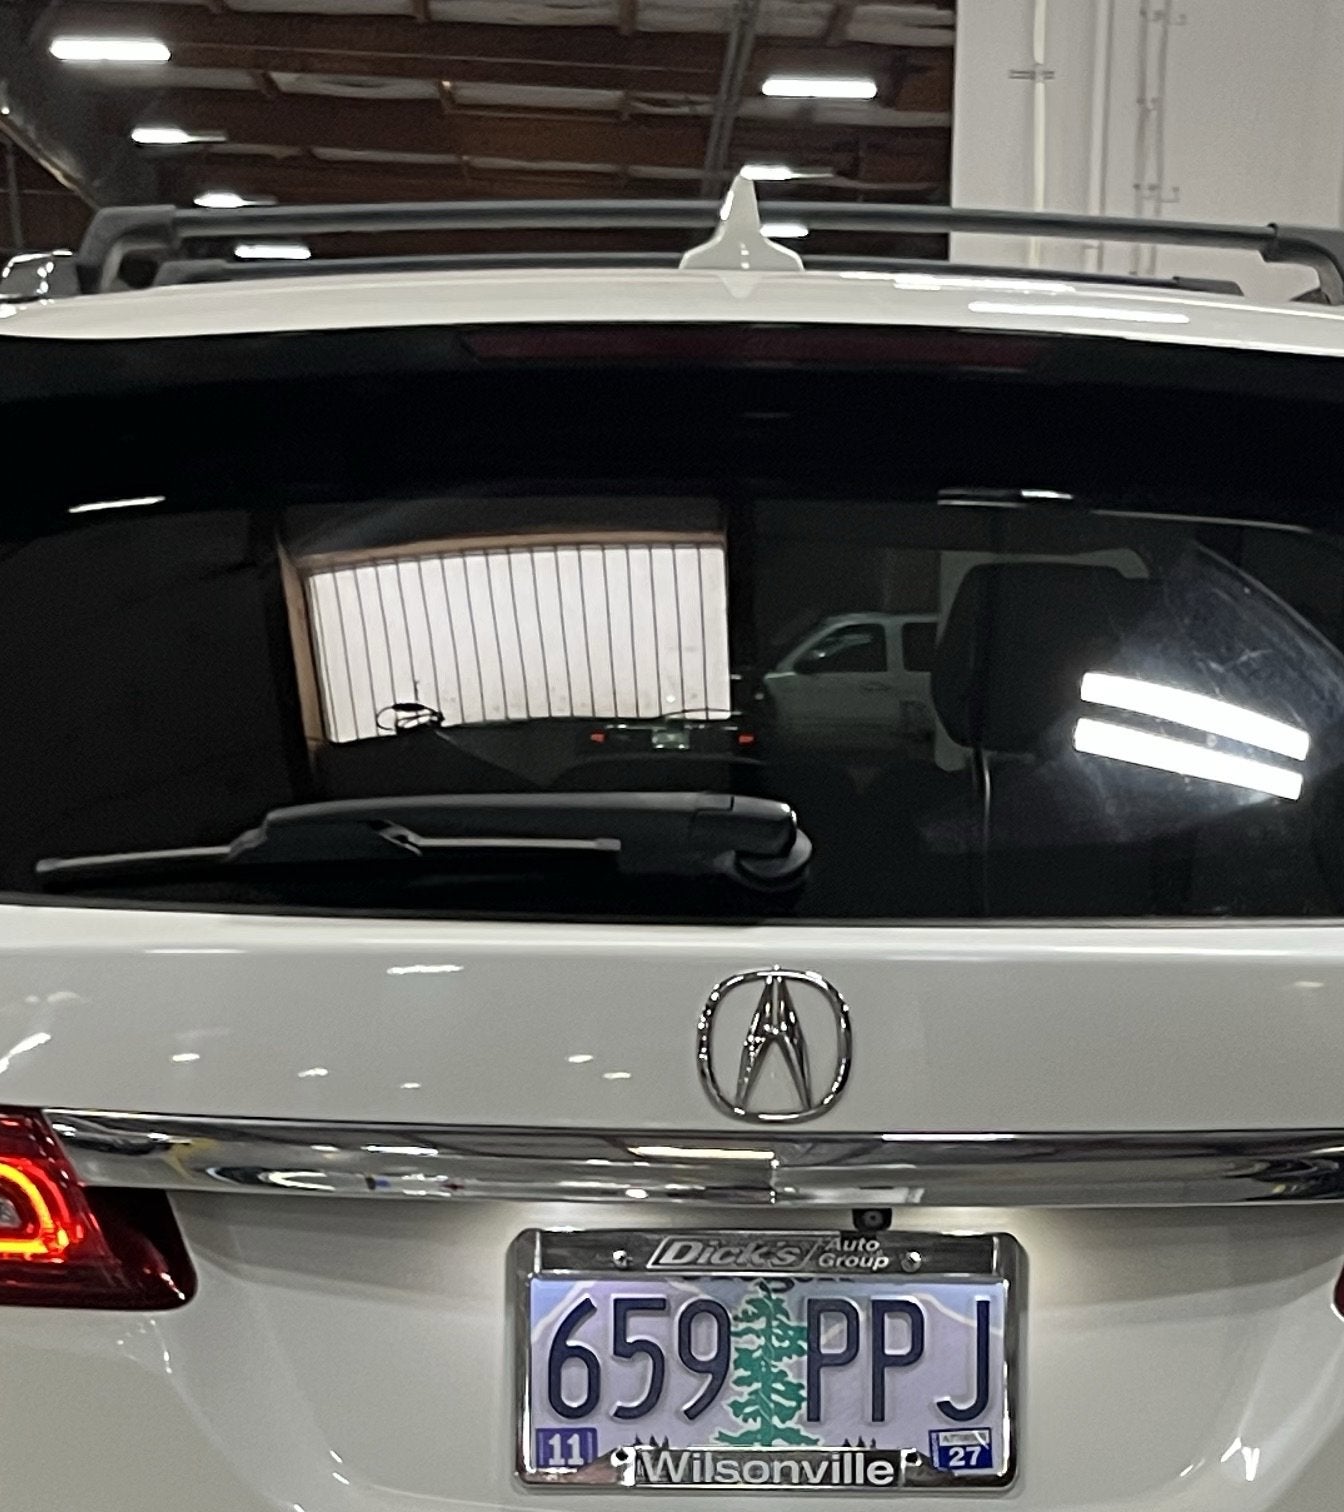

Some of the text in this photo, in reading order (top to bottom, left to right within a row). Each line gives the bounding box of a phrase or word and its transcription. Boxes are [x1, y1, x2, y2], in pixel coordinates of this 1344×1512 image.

[658, 1239, 803, 1268] Dick's
[824, 1238, 880, 1253] Auto
[818, 1252, 891, 1272] Group
[547, 1296, 992, 1423] 659 PPJ
[548, 1433, 584, 1466] 11
[948, 1446, 982, 1467] 27
[640, 1449, 895, 1486] Wilsonville
